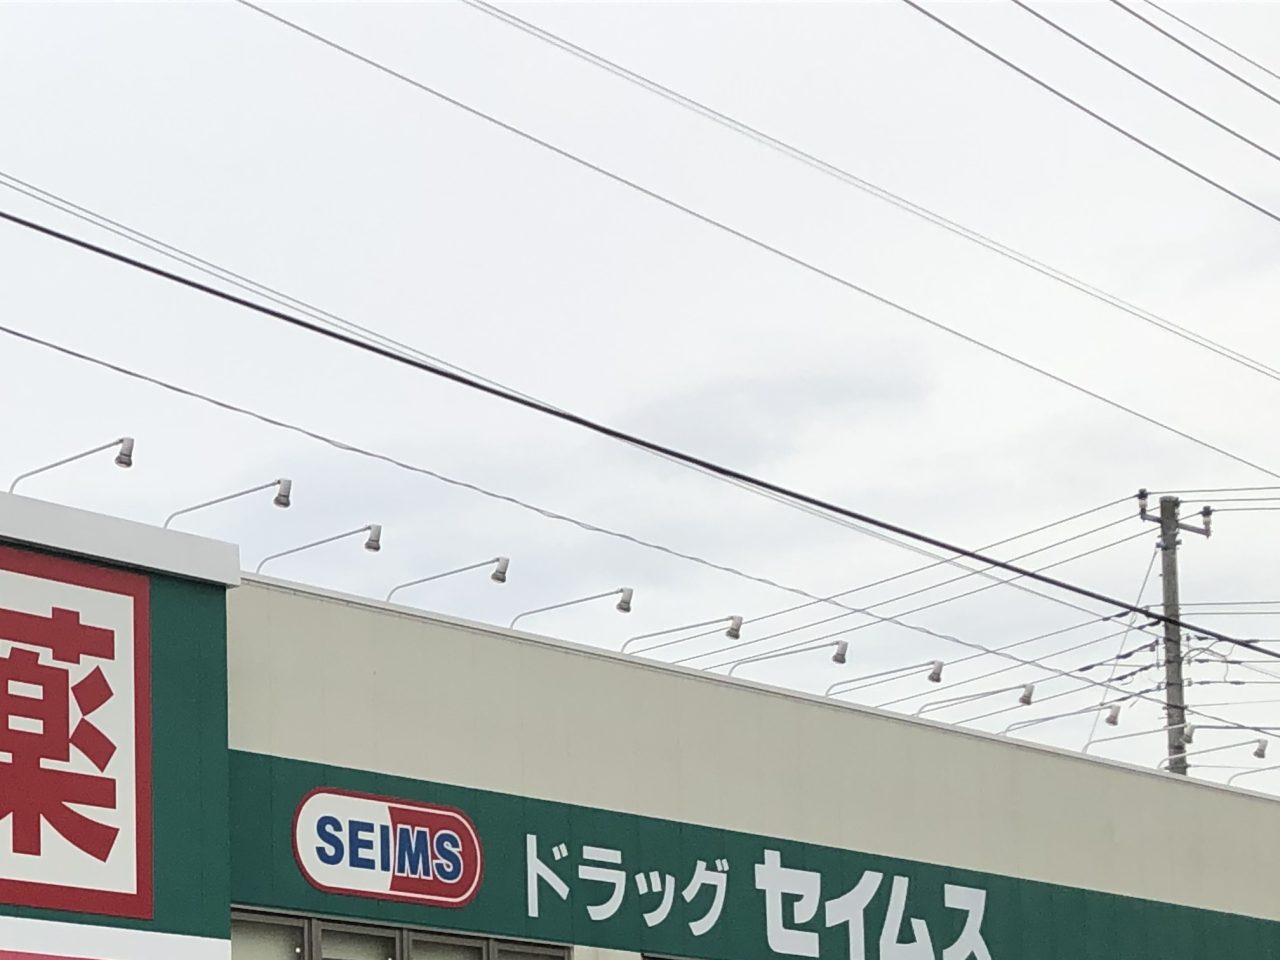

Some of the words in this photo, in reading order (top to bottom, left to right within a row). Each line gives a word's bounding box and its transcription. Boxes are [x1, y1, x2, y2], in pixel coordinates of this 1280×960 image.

[315, 815, 463, 883] SEIMS
[527, 834, 729, 936] ドラッグ
